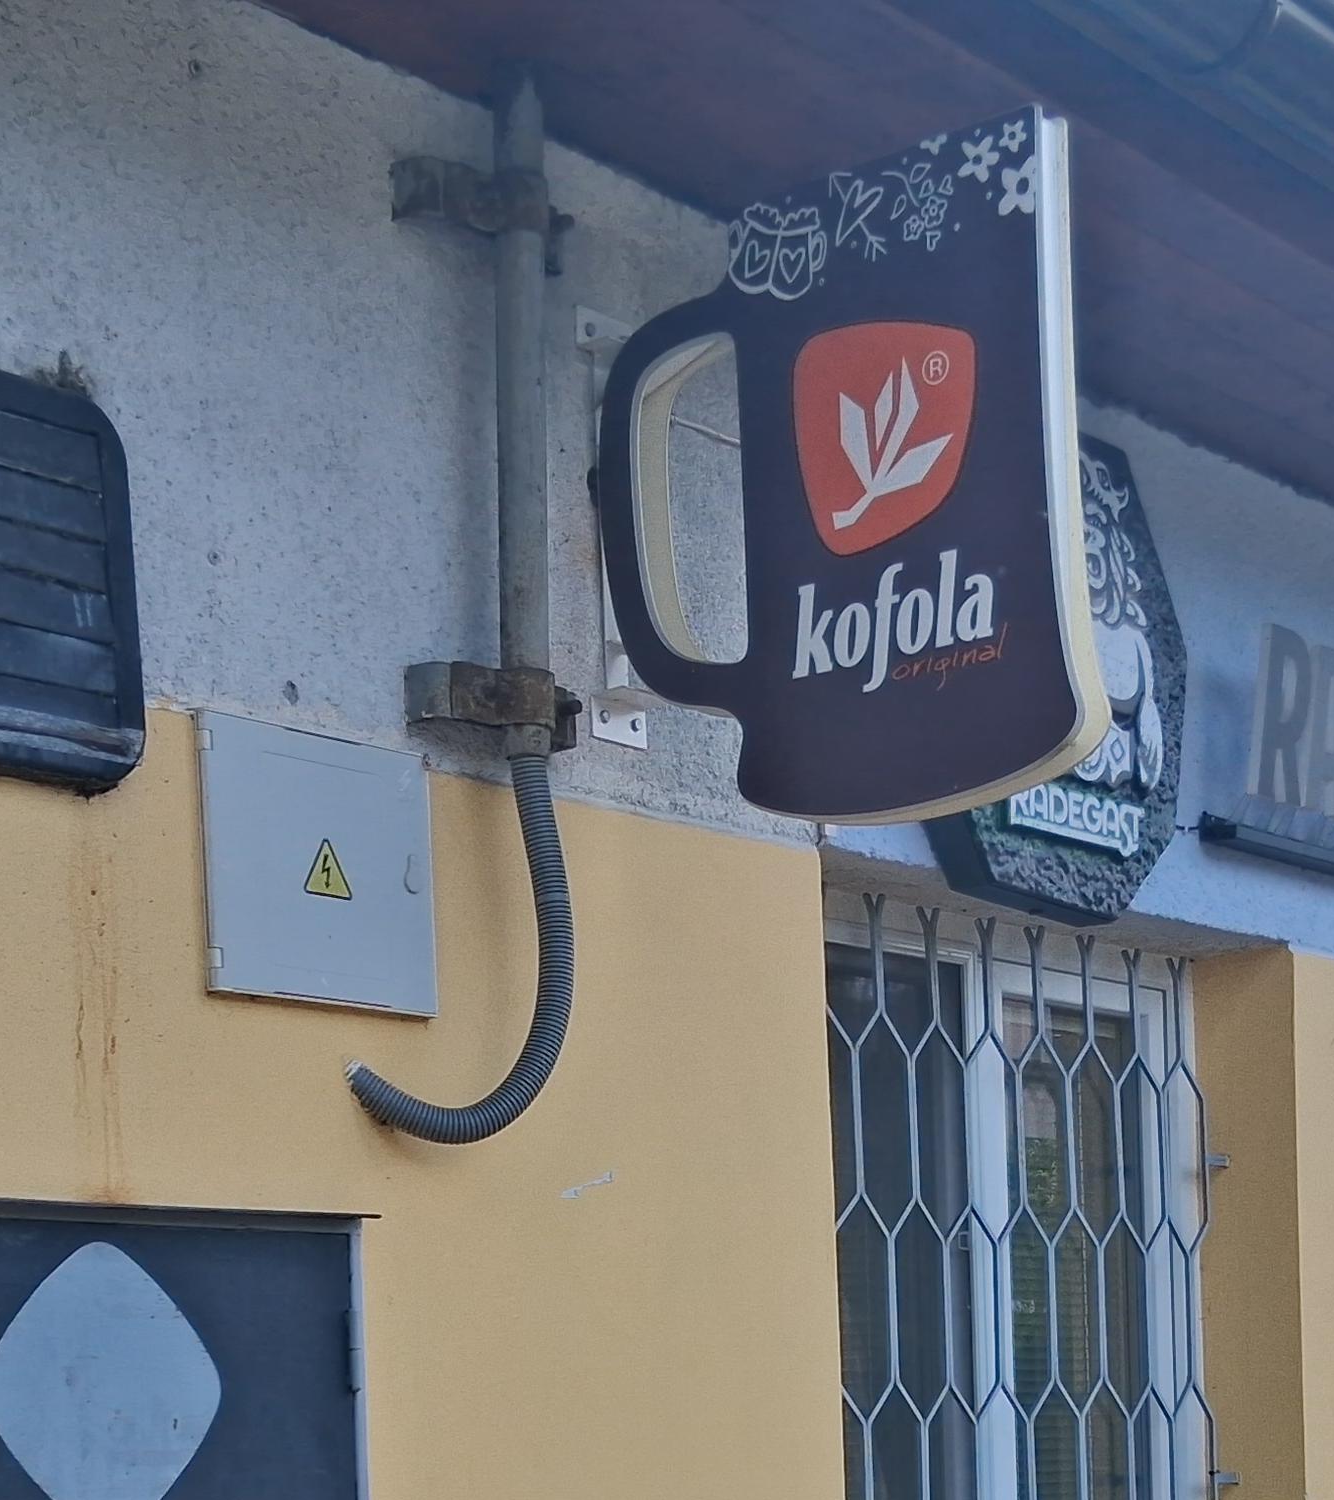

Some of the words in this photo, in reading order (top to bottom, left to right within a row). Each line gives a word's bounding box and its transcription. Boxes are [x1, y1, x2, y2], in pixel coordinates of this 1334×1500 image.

[792, 549, 994, 693] kofola
[892, 622, 1009, 691] original
[1010, 782, 1145, 858] RADEGAST
